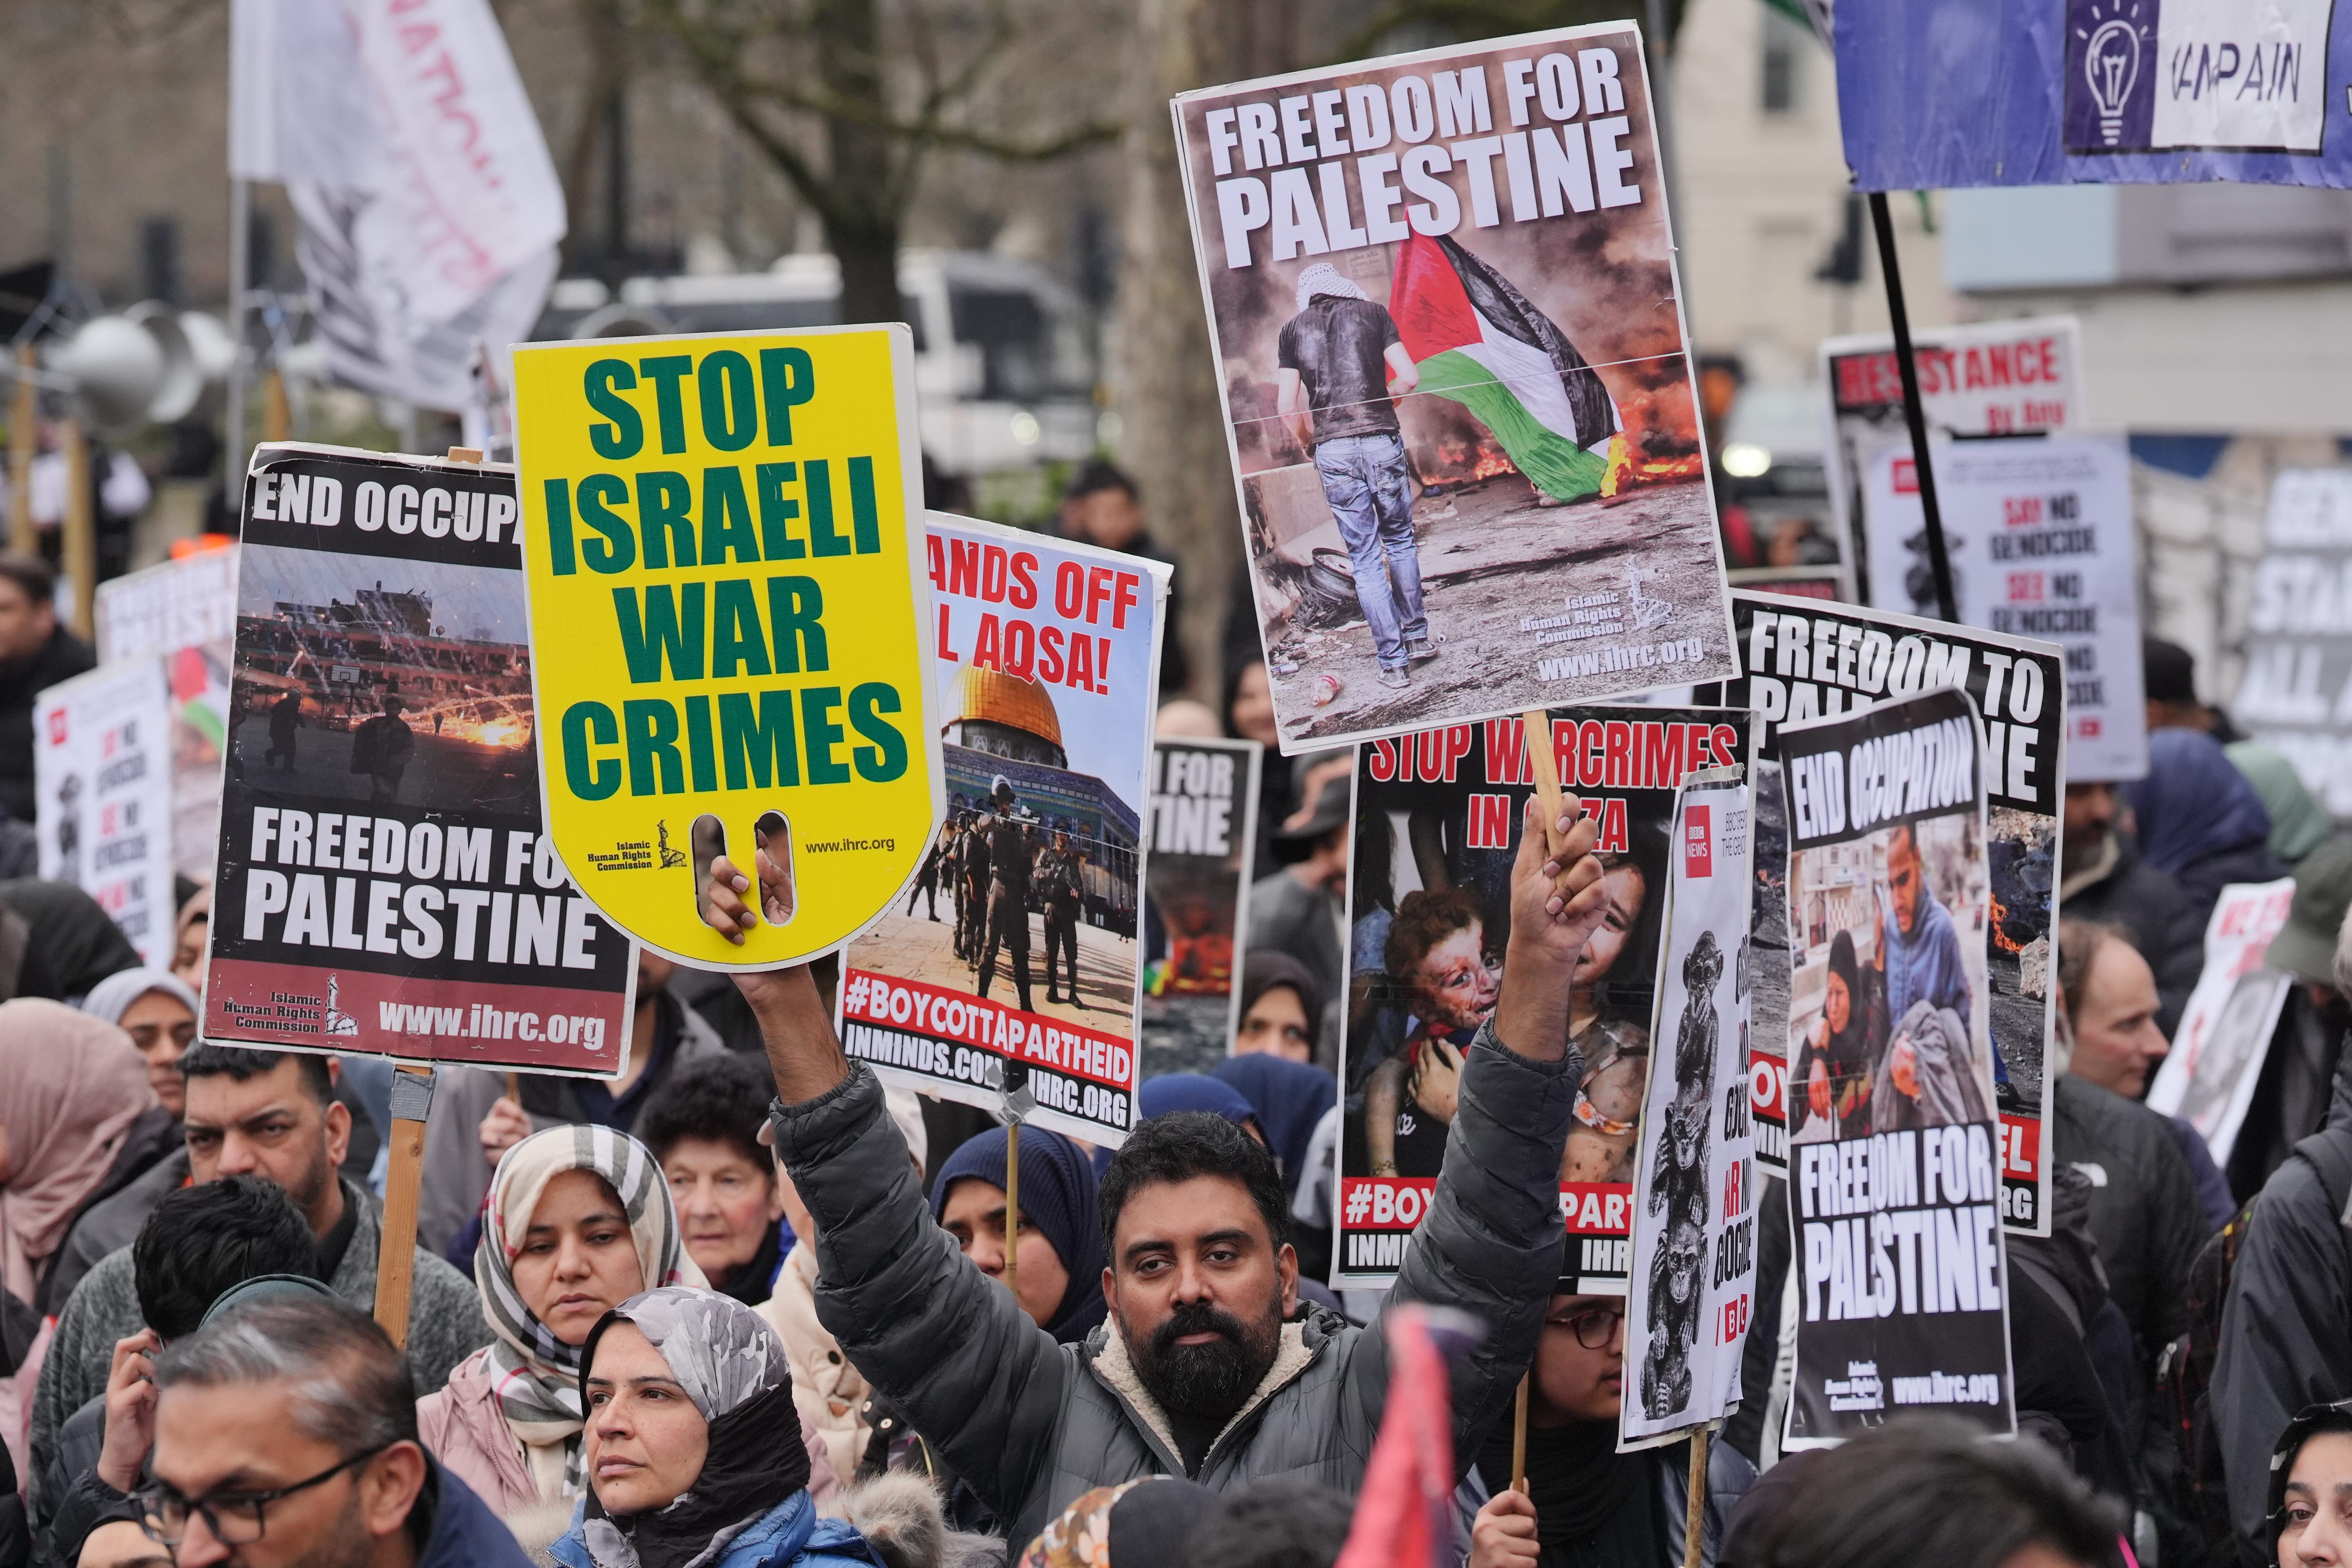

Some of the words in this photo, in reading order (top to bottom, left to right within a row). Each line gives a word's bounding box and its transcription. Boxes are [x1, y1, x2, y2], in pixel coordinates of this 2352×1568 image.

[1205, 65, 1492, 176] FREEDOM
[1503, 47, 1625, 127] FOR
[1216, 115, 1641, 270] PALESTINE
[584, 347, 815, 460] STOP
[253, 472, 343, 526] END
[354, 481, 521, 545] OCCUP
[544, 456, 881, 576] ISRAELI
[926, 534, 1039, 610] ANDS
[1054, 560, 1139, 630] OFF
[1564, 591, 1620, 610] Islamic
[612, 575, 829, 684] WAR
[1520, 614, 1571, 632] Human
[1573, 606, 1622, 624] Rights
[1535, 621, 1624, 645] Commission
[973, 612, 1112, 696] AQSA!
[1537, 637, 1704, 682] www.ihrc.org
[1749, 609, 1971, 698] FREEDOM
[1983, 651, 2044, 724] TO
[561, 682, 908, 801] CRIMES
[1167, 750, 1235, 796] FOR
[1791, 750, 1846, 840] END
[250, 806, 493, 883] FREEDOM
[505, 830, 575, 889] FO
[617, 840, 650, 850] Islamic
[806, 838, 895, 853] www.ihrc.org
[1466, 793, 1511, 849] IN
[1689, 826, 1705, 840] BBC
[1722, 837, 1733, 857] THE
[588, 853, 619, 862] Human
[622, 851, 652, 861] Rights
[597, 860, 652, 871] Commission
[1686, 842, 1708, 858] NEWS
[243, 868, 598, 969] PALESTINE
[223, 1001, 271, 1016] Human
[276, 1005, 320, 1020] Rights
[236, 1016, 319, 1033] Commission
[270, 991, 321, 1006] Islamic
[379, 1001, 605, 1050] www.ihrc.org
[845, 975, 1131, 1083] #BOYCOTTAPARTHEID
[1028, 1068, 1127, 1127] IHRC.ORG
[1923, 1124, 1994, 1205] FOR
